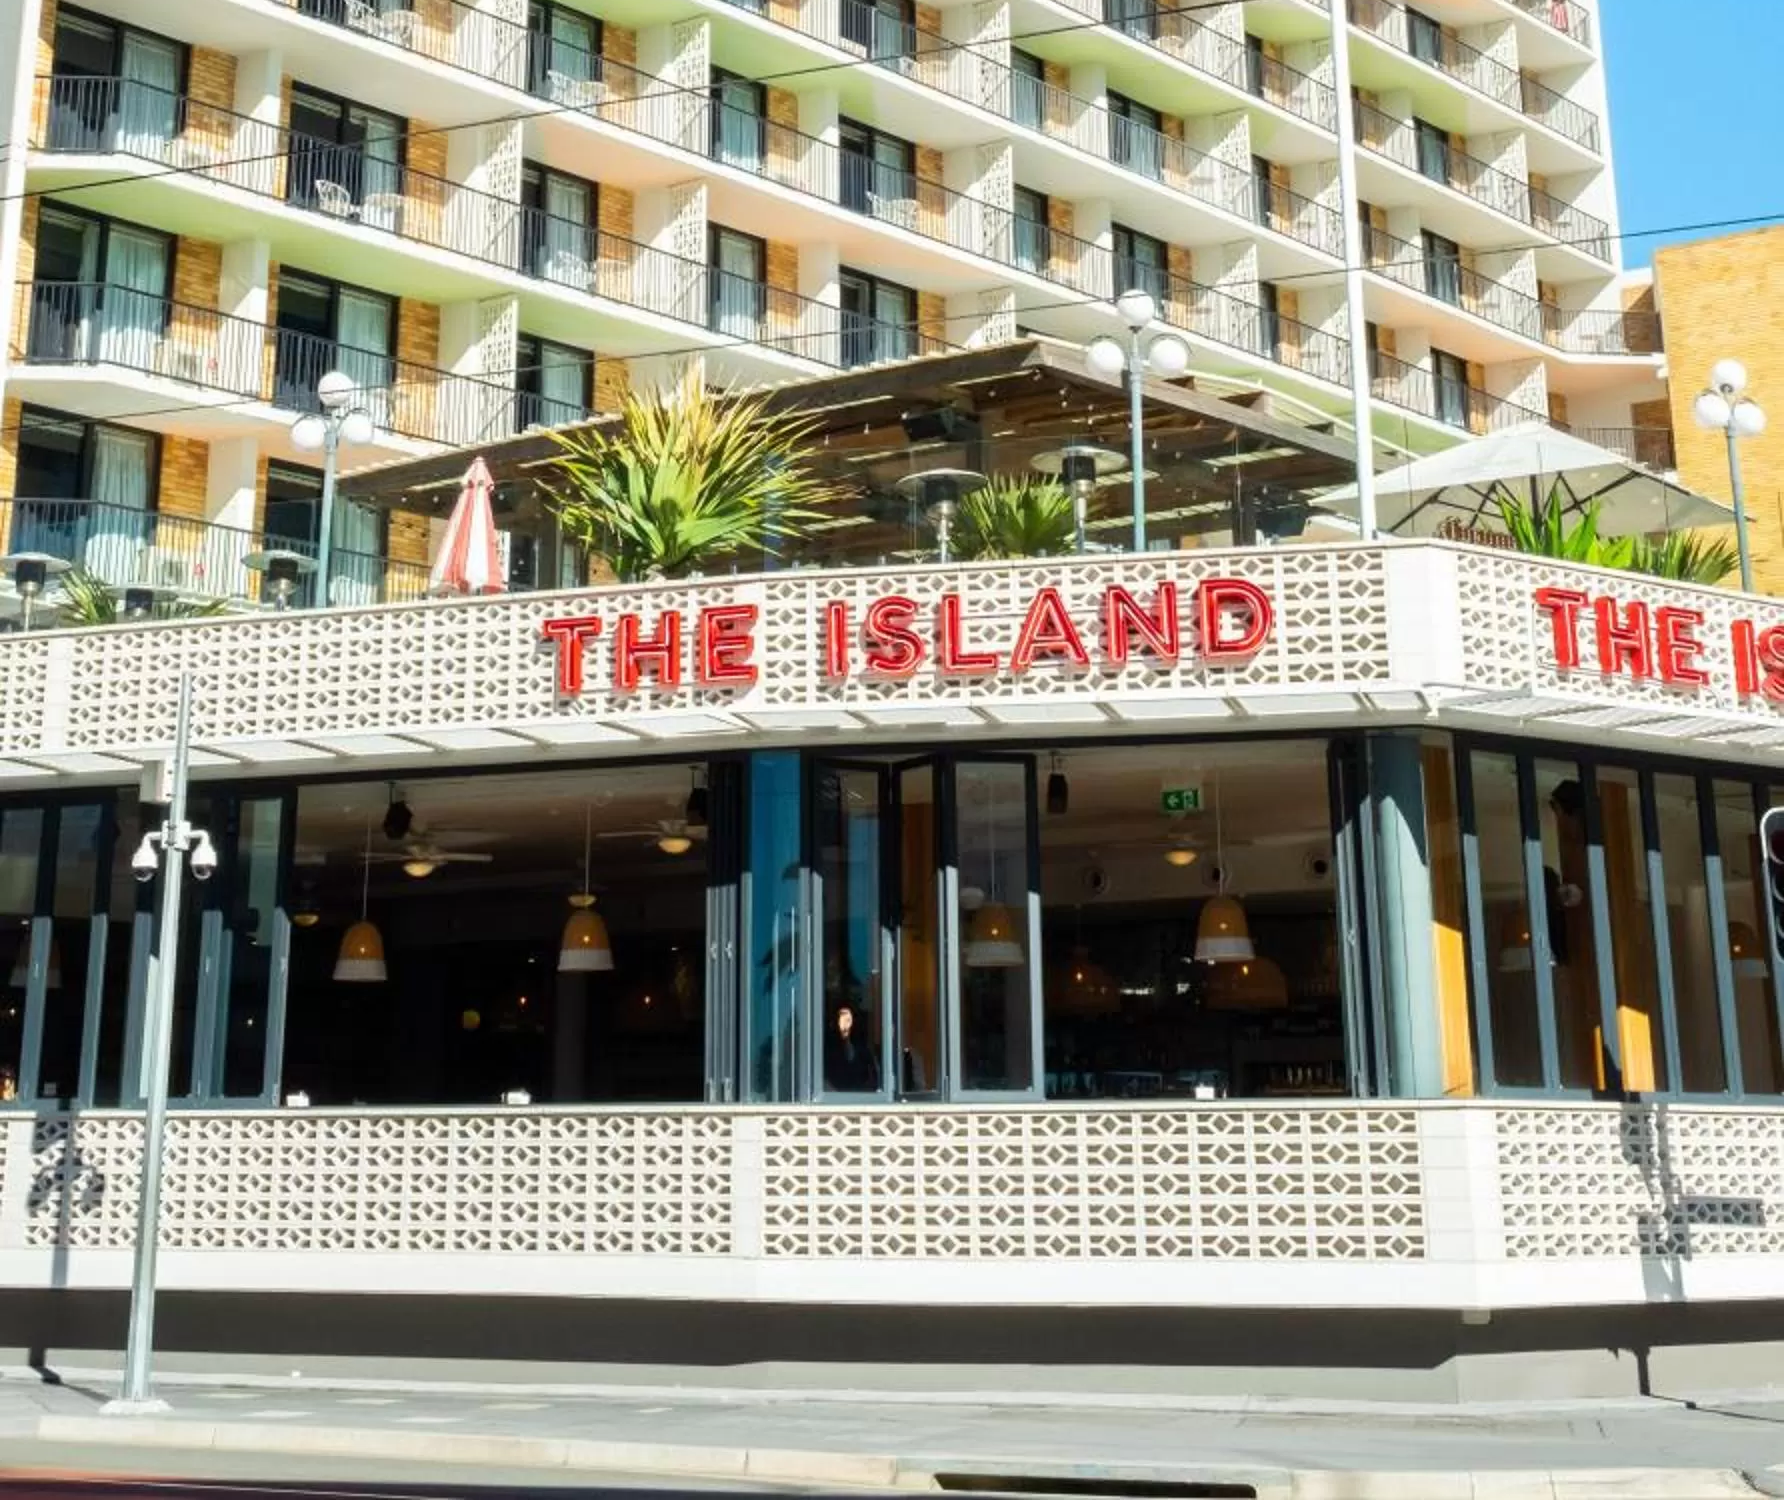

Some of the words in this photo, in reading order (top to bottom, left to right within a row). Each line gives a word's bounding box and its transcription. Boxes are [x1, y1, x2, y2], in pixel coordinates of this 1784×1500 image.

[543, 604, 760, 696] THE
[825, 578, 1274, 677] ISLAND
[1534, 587, 1710, 685] THE
